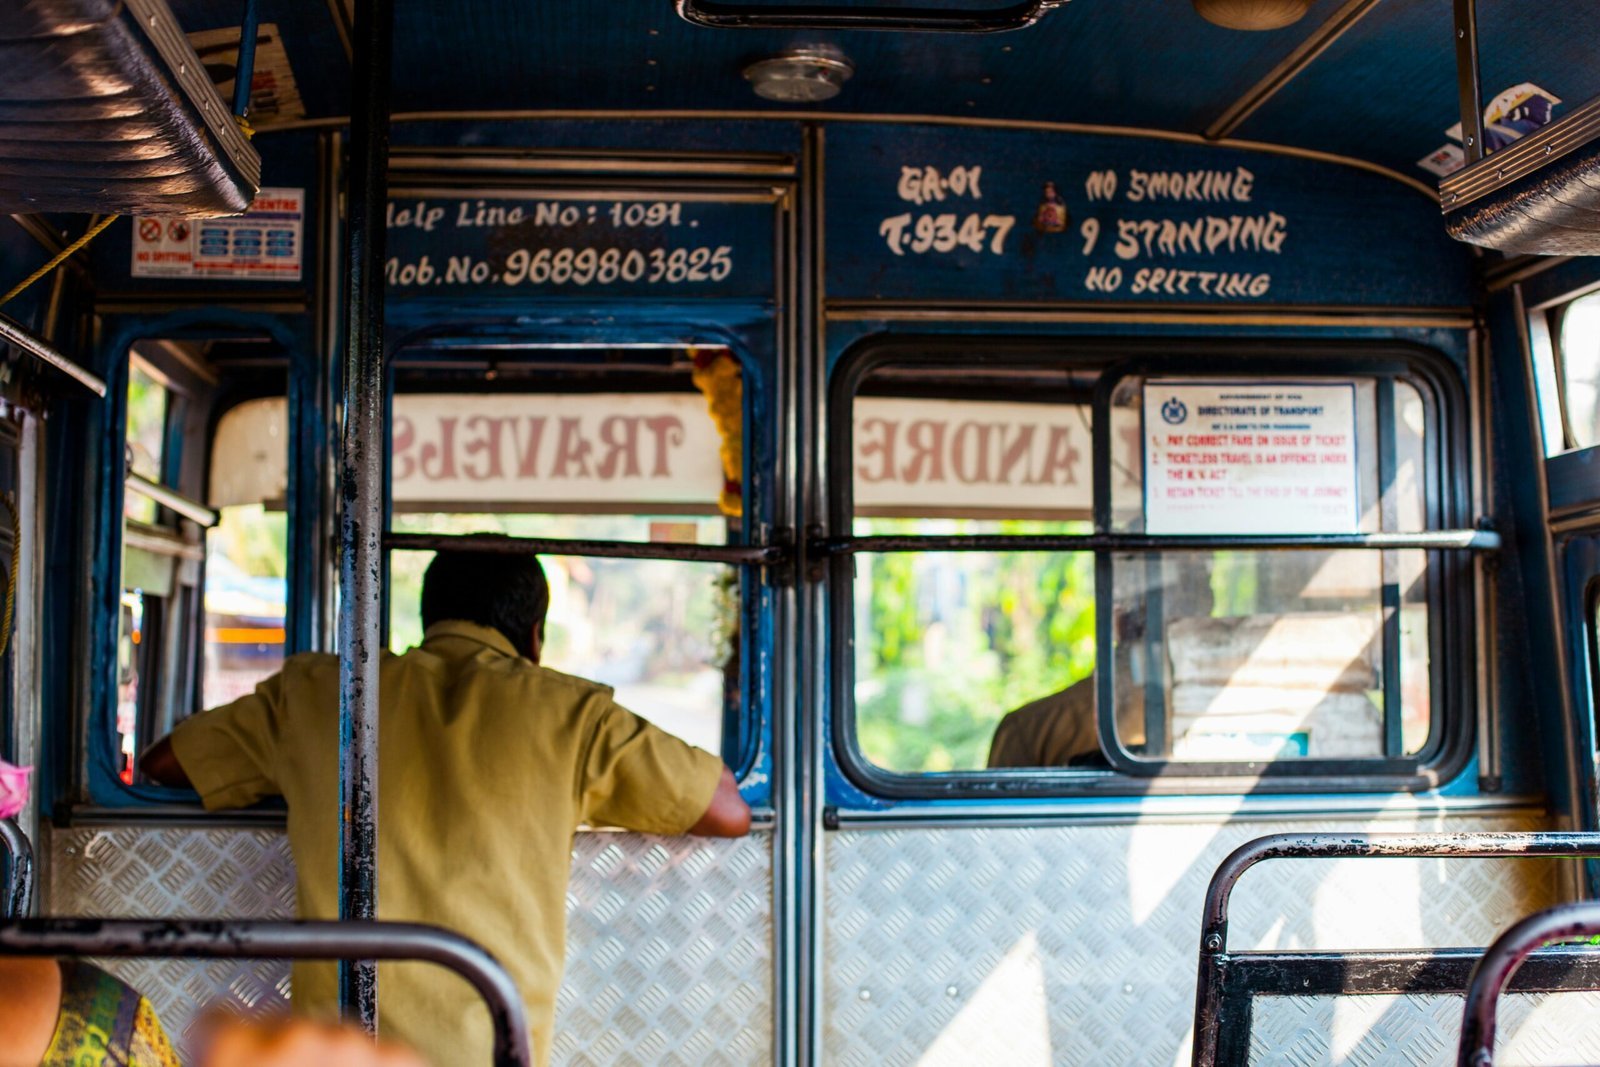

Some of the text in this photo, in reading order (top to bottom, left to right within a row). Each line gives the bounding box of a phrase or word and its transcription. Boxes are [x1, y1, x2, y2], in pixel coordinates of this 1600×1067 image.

[1085, 166, 1255, 202] NO SMOKING
[1081, 211, 1288, 260] 9 STANDING
[503, 246, 733, 286] 9689803825
[1084, 266, 1271, 297] NO SPITTING
[1198, 406, 1324, 416] DIRECTORATE OF TRANSPORT
[1167, 434, 1184, 446] PAY
[1187, 434, 1228, 446] CORRECT
[1231, 434, 1253, 446] FARE
[1257, 434, 1268, 446] ON
[1273, 434, 1297, 446] ISSUE
[1302, 434, 1311, 446] OF
[1315, 434, 1345, 446] TICKET
[1167, 452, 1218, 465] TICKETLESS
[1220, 452, 1251, 465] TRAVEL
[1280, 453, 1317, 465] OFFENCE
[1321, 453, 1347, 465] UNDER
[1167, 469, 1183, 480] THE
